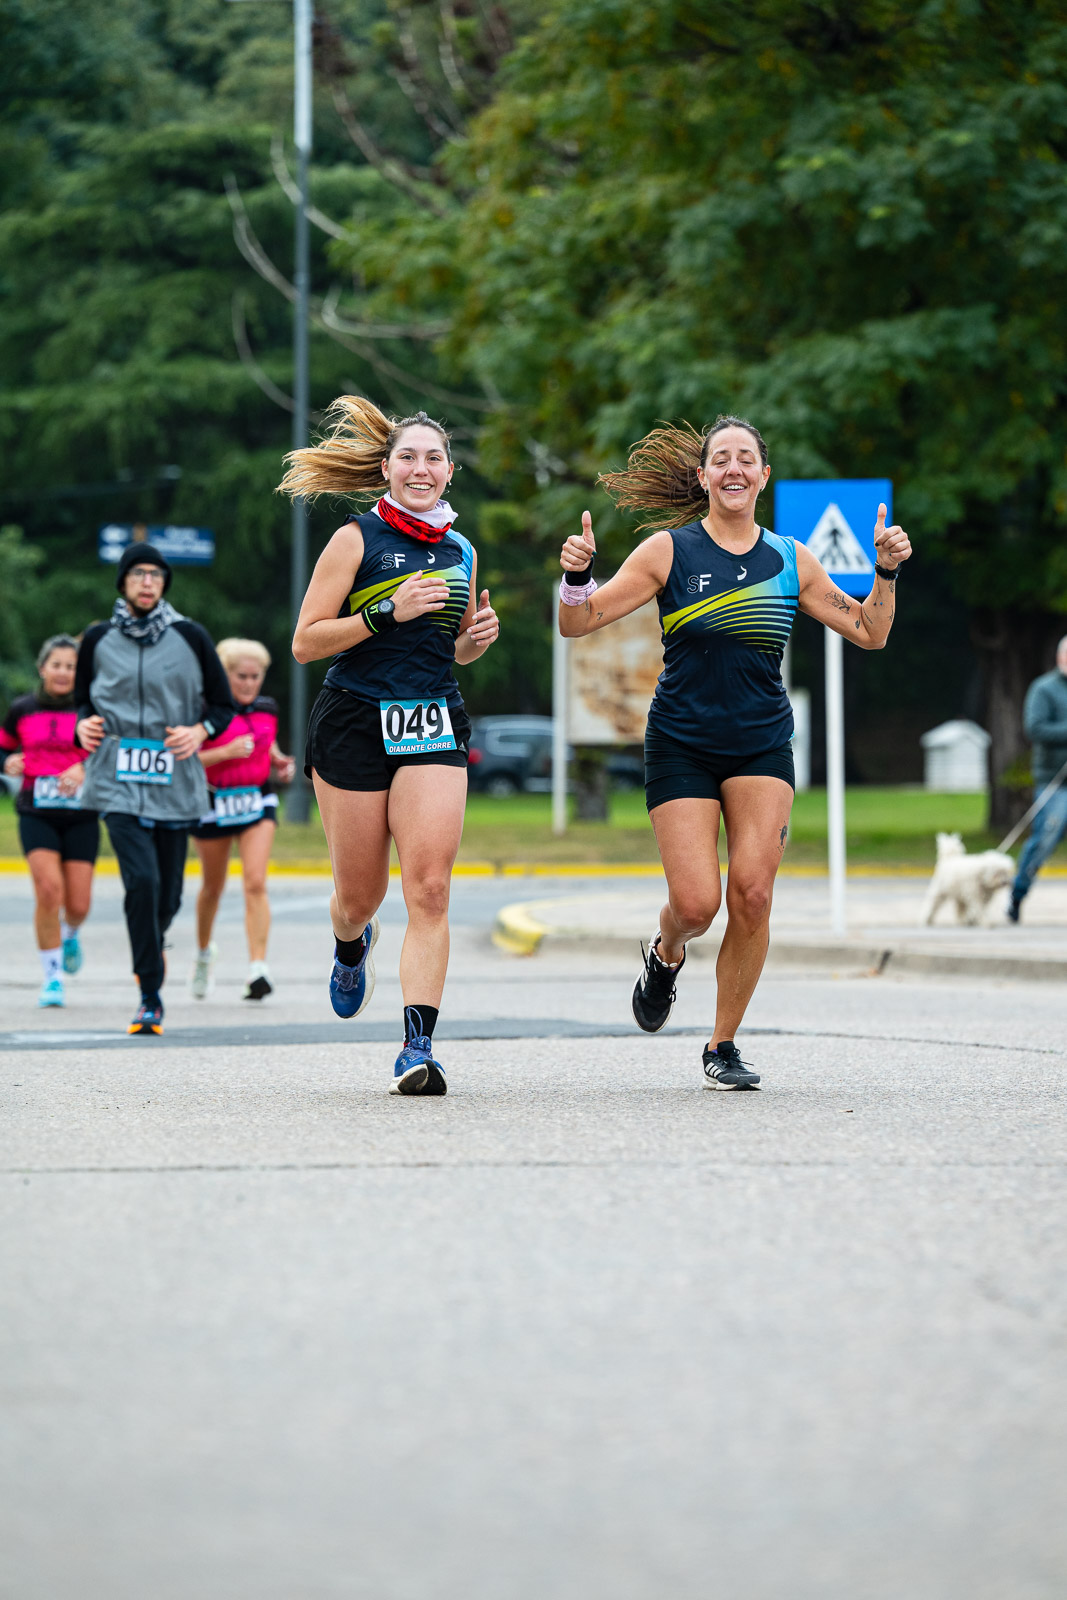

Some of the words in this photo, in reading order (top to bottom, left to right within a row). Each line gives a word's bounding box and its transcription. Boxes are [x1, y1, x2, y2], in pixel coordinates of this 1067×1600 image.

[381, 553, 406, 570] SF
[687, 573, 712, 594] SF
[386, 701, 444, 744] 049
[389, 744, 426, 753] DIAMANTE
[427, 741, 452, 751] CORRE
[125, 747, 167, 774] 106
